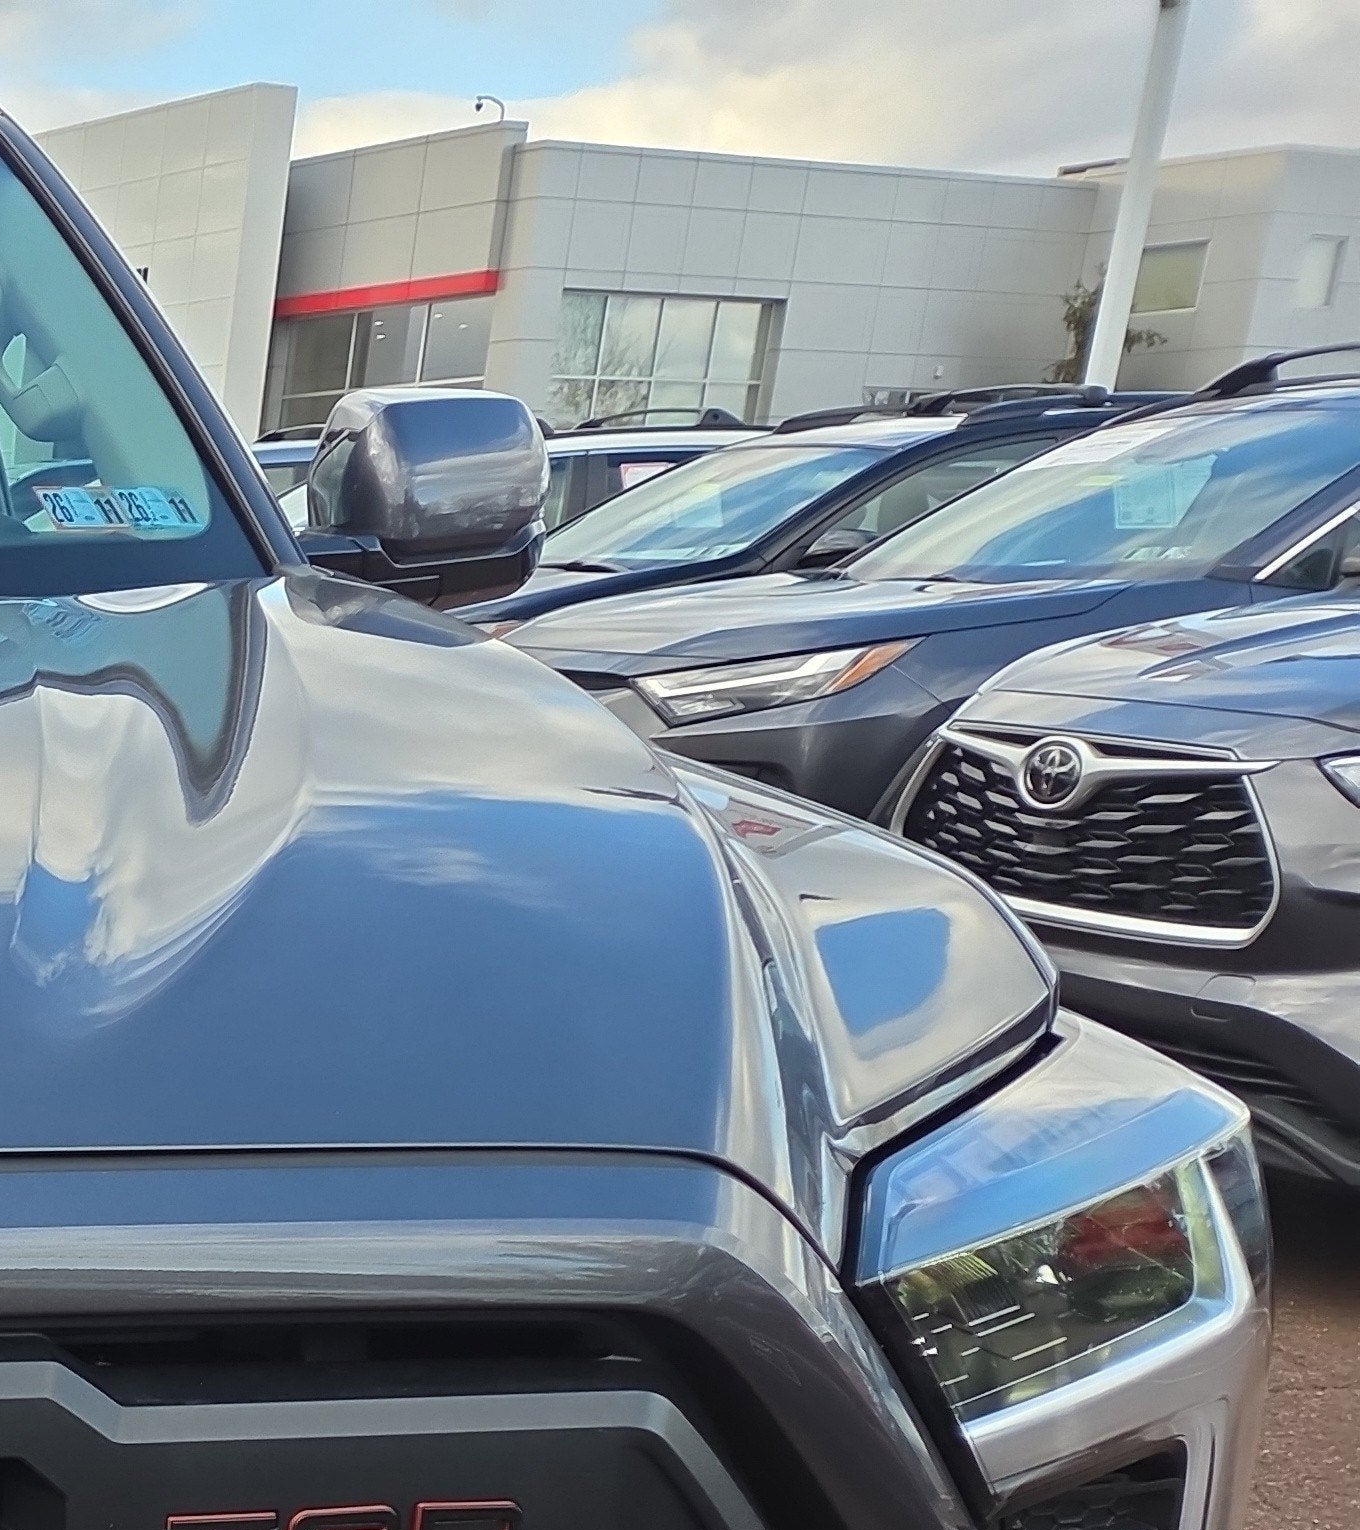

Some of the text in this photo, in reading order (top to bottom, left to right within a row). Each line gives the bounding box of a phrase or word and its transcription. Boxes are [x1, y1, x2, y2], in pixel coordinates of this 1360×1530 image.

[42, 492, 125, 524] 26 11
[117, 491, 199, 524] 26 11
